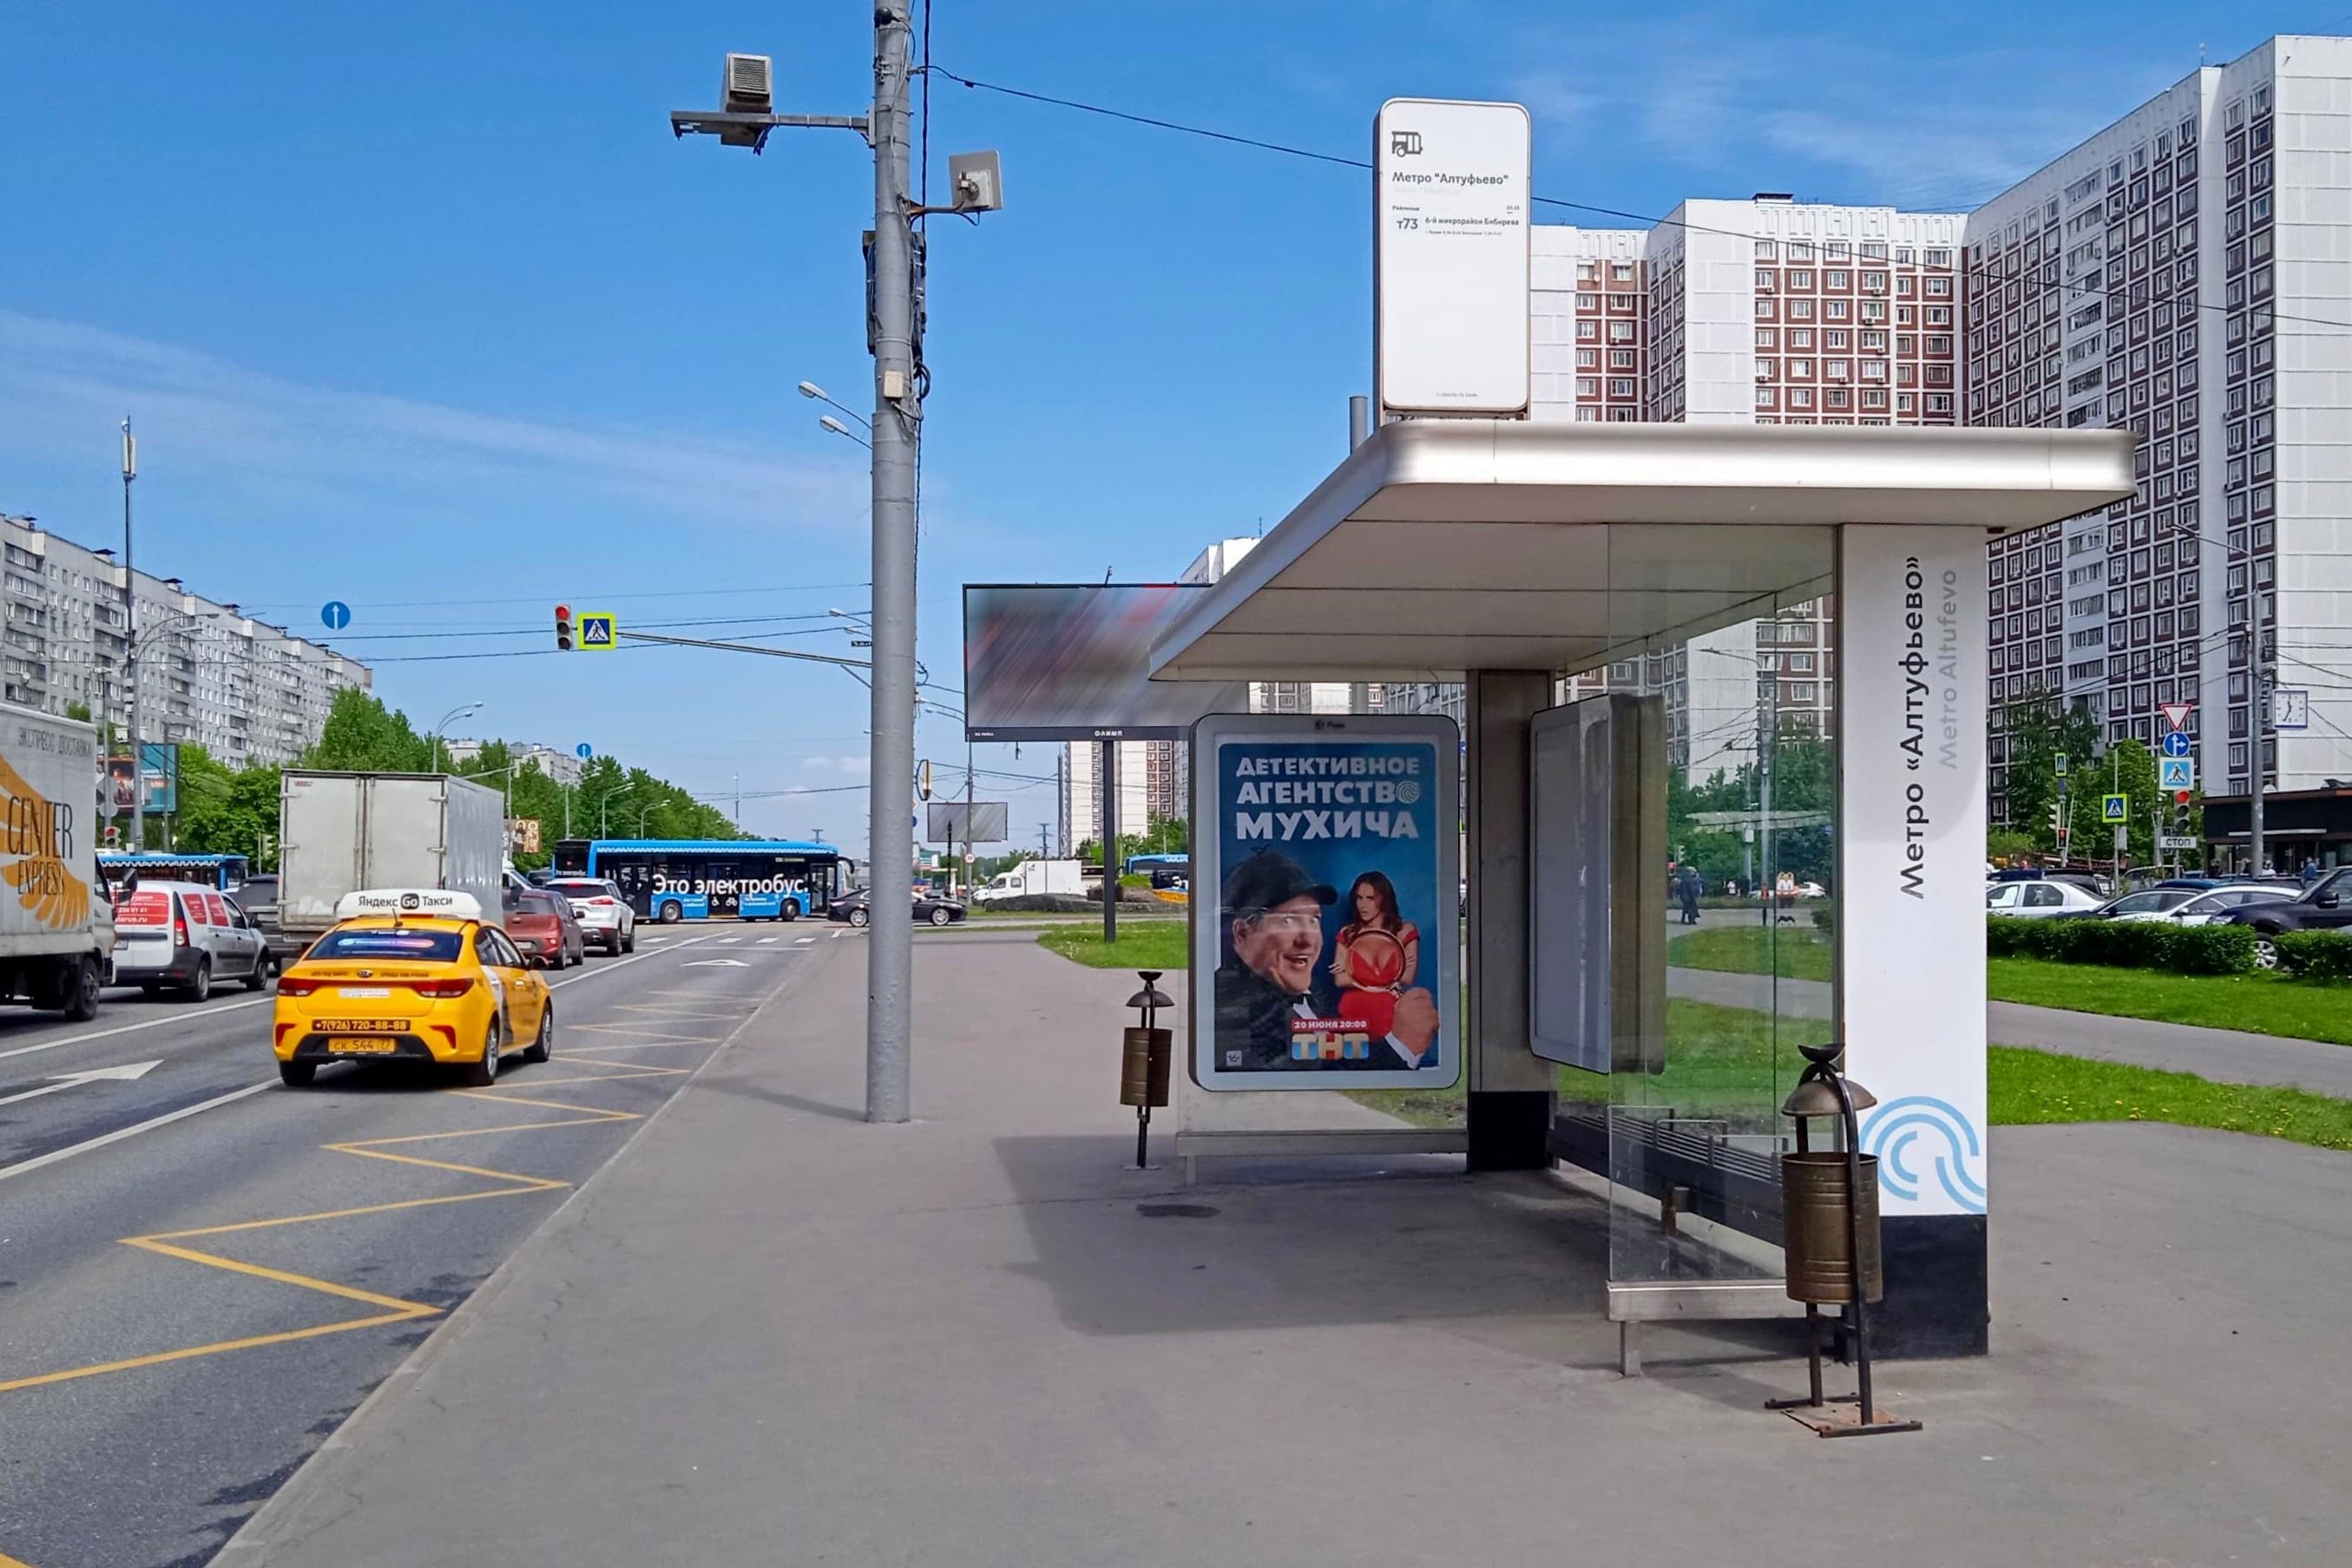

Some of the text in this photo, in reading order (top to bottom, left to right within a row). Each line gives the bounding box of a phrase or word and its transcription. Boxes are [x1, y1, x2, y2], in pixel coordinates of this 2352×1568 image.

[1392, 172, 1508, 187] Метро "Алтуфьево"
[1396, 218, 1419, 230] т73
[1438, 217, 1483, 226] микрорайон
[1484, 218, 1520, 226] Бибирева
[1937, 570, 1957, 770] Metro Altufevo
[1898, 556, 1929, 900] Метро «Алтуфьево»
[1236, 757, 1420, 777] ДЕТЕКТИВНОЕ
[1236, 781, 1421, 804] АГЕНТСТВО
[8, 796, 74, 860] CENTER
[1236, 810, 1420, 841] МУХИЧА
[2166, 838, 2191, 847] СТОП
[17, 859, 65, 896] EXPRESS
[652, 873, 809, 897] Это электробус.
[358, 894, 452, 908] Яндекс Go Такси
[352, 1020, 407, 1030] 720-88-88
[1291, 1033, 1370, 1060] ТНТ
